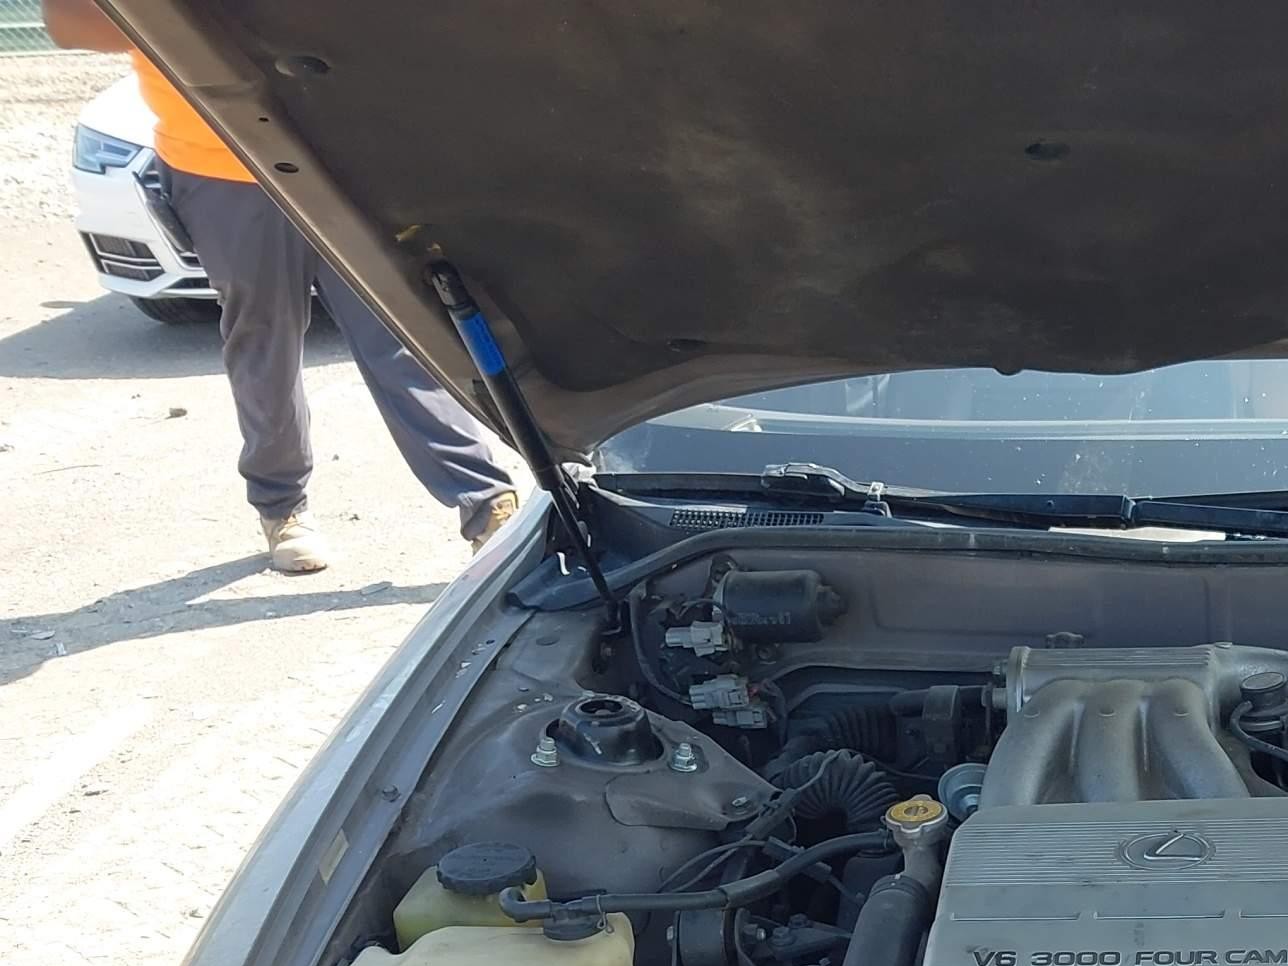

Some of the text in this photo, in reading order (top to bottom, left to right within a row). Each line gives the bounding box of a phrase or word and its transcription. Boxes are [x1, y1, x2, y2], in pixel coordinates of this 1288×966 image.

[1031, 951, 1121, 966] 3000
[1135, 950, 1218, 966] FOUR
[1225, 949, 1288, 964] CAM
